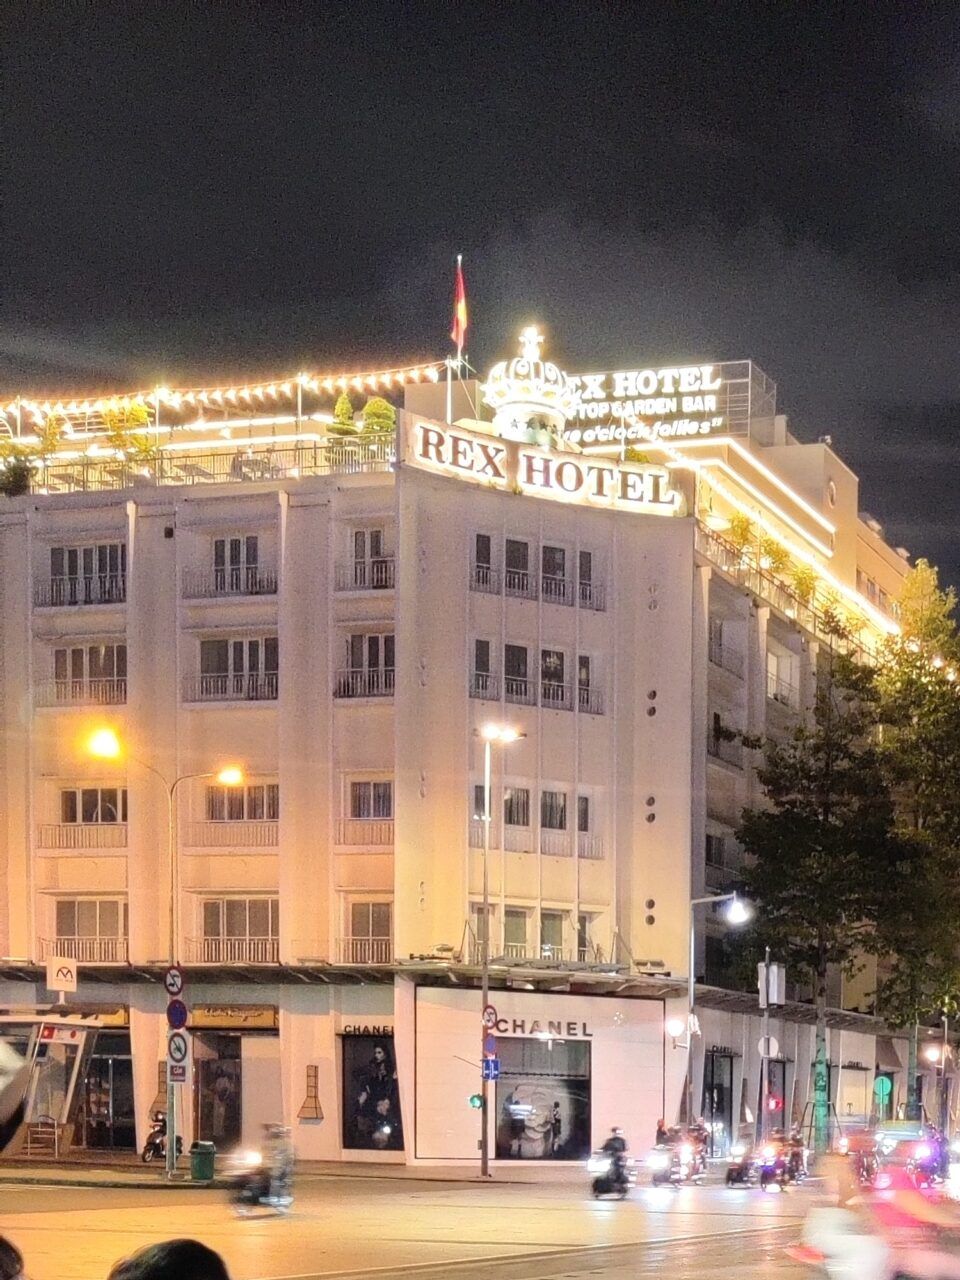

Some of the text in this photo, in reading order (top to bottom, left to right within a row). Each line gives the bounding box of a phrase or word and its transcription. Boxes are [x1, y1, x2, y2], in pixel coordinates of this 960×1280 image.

[566, 366, 722, 399] EX HOTEL
[612, 398, 677, 417] GARDEN
[682, 395, 717, 412] BAR
[419, 426, 675, 506] REX HOTEL
[496, 1019, 593, 1037] CHANEL
